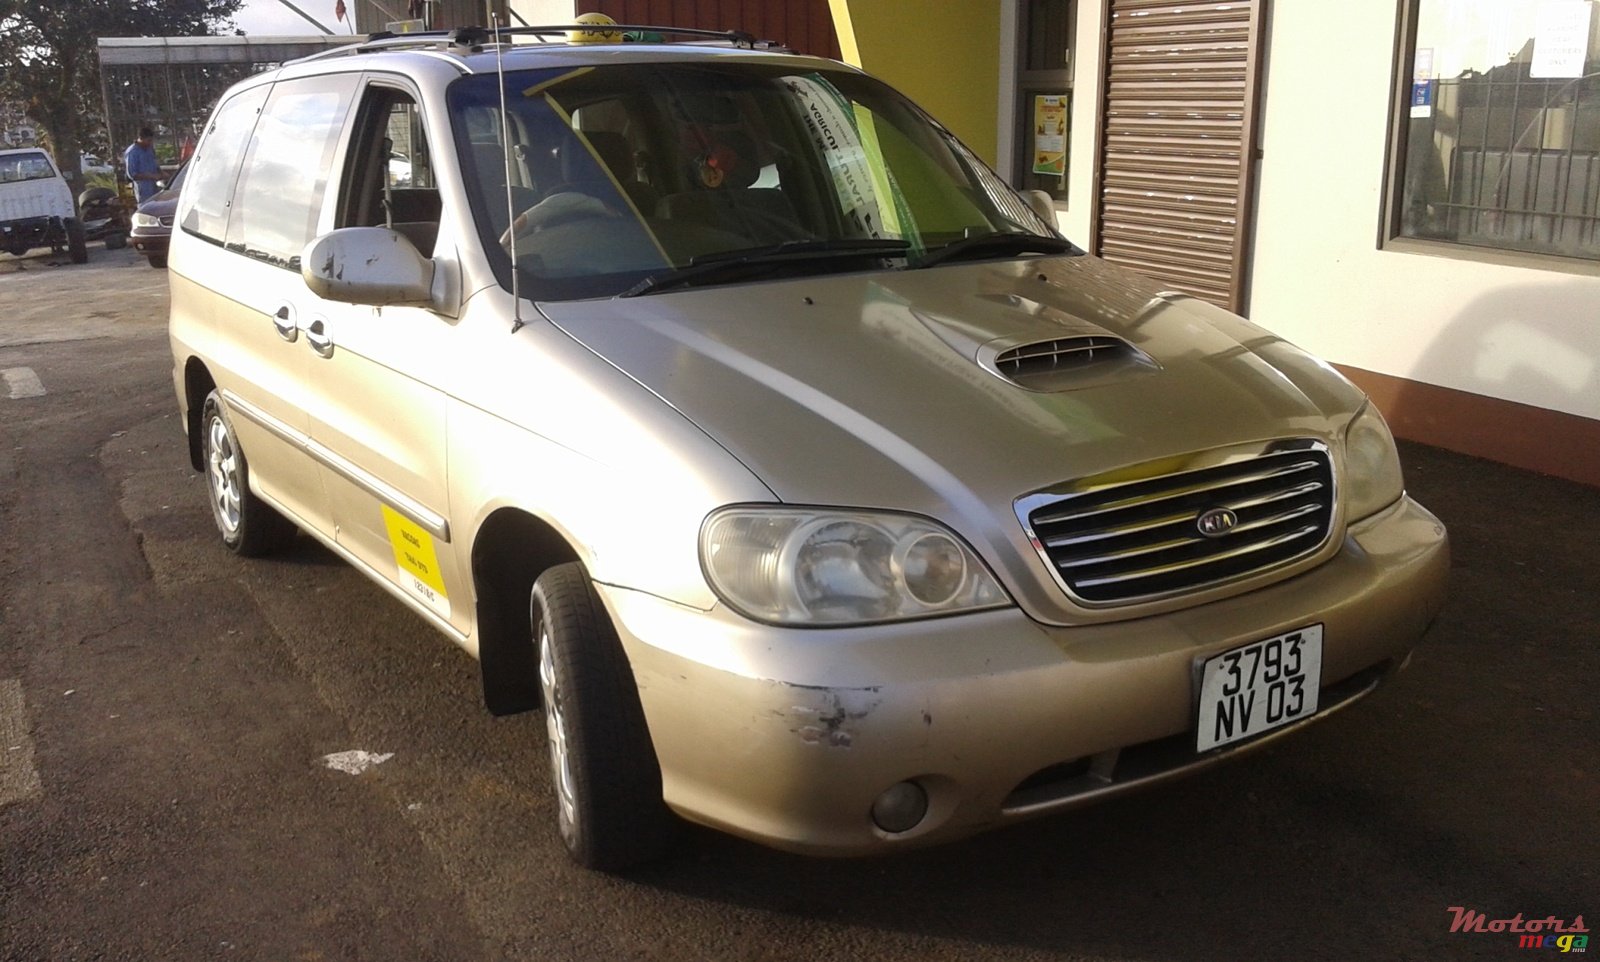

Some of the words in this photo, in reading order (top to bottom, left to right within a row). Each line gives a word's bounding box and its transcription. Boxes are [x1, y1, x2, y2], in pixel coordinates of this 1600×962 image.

[1204, 513, 1233, 532] KIA
[1222, 632, 1302, 697] 3793
[1214, 690, 1256, 742] NV
[1266, 674, 1306, 724] 03
